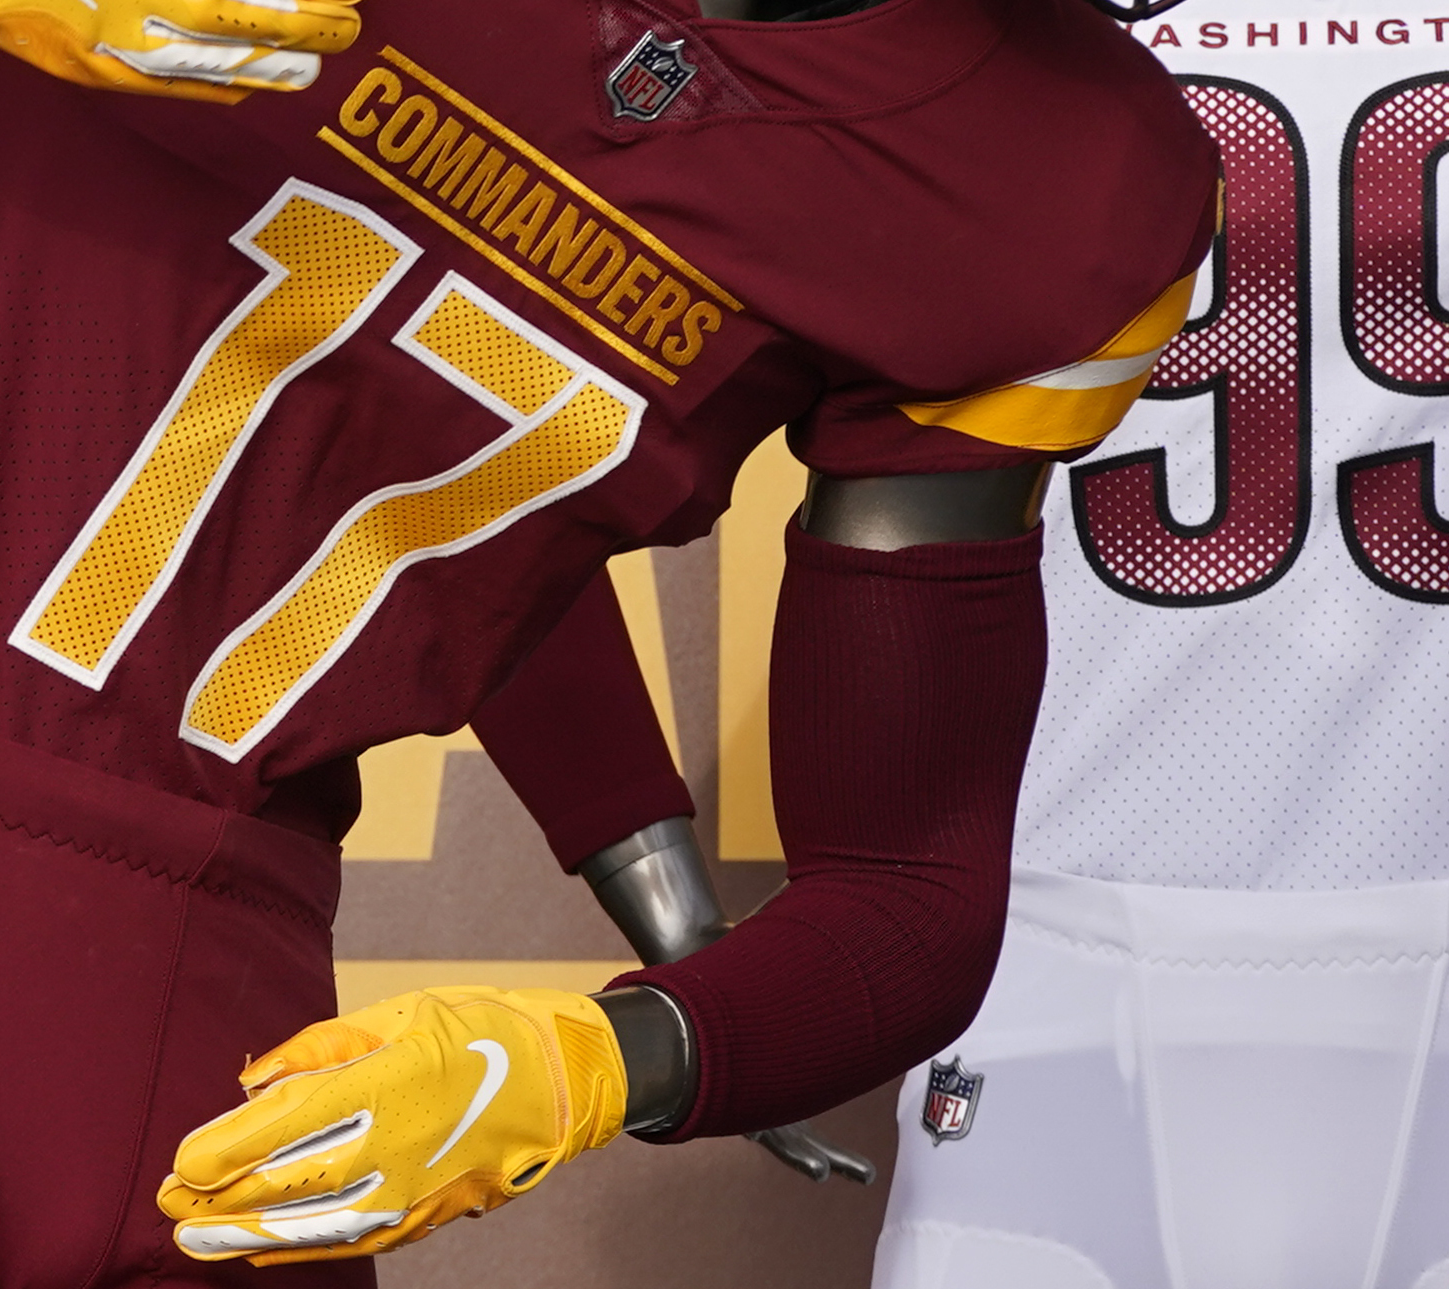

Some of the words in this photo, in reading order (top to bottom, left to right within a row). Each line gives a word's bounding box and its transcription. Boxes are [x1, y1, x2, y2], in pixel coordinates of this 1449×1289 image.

[617, 64, 665, 111] NFL
[339, 67, 722, 366] COMMANDERS
[9, 175, 648, 764] 17
[927, 1092, 963, 1128] NFL
